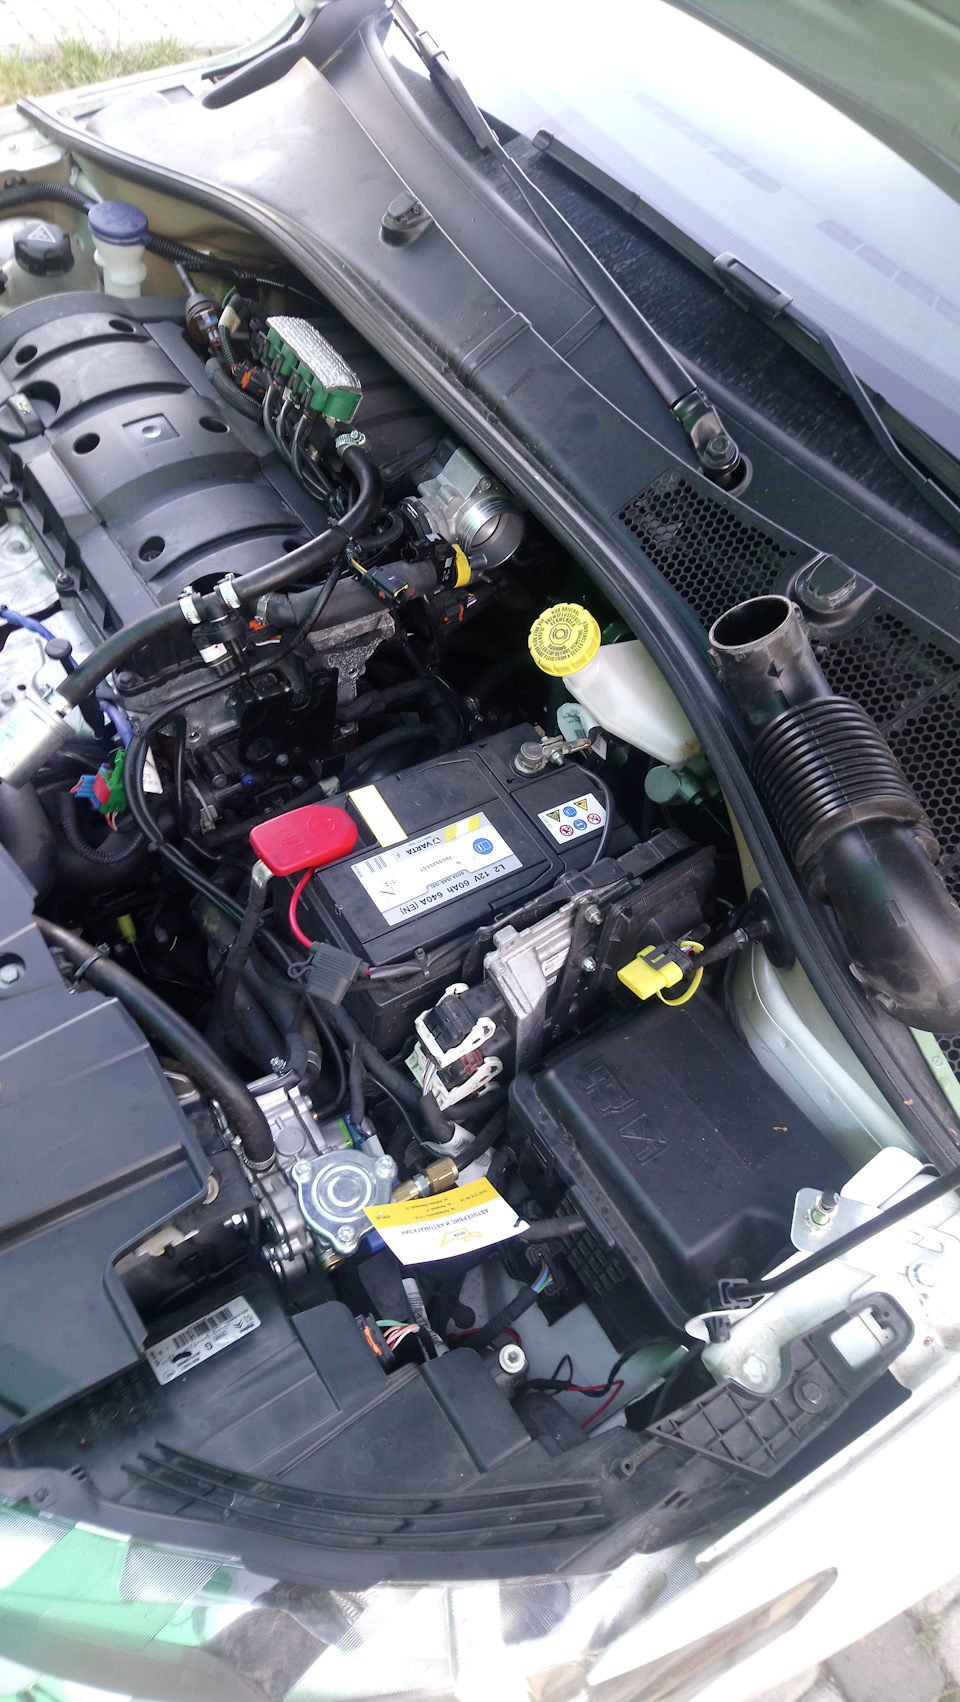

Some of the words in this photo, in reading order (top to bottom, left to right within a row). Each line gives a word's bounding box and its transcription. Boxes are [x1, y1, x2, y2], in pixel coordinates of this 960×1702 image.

[405, 841, 432, 856] VARTA
[493, 863, 506, 873] L2
[473, 870, 490, 882] 12V
[446, 880, 470, 893] 60Ah
[419, 891, 444, 905] 640A
[399, 901, 419, 915] (EN)
[450, 1208, 489, 1226] АВТОСЕРВИС
[401, 1222, 445, 1236] АВТОМАГАЗИН
[204, 1342, 213, 1351] G
